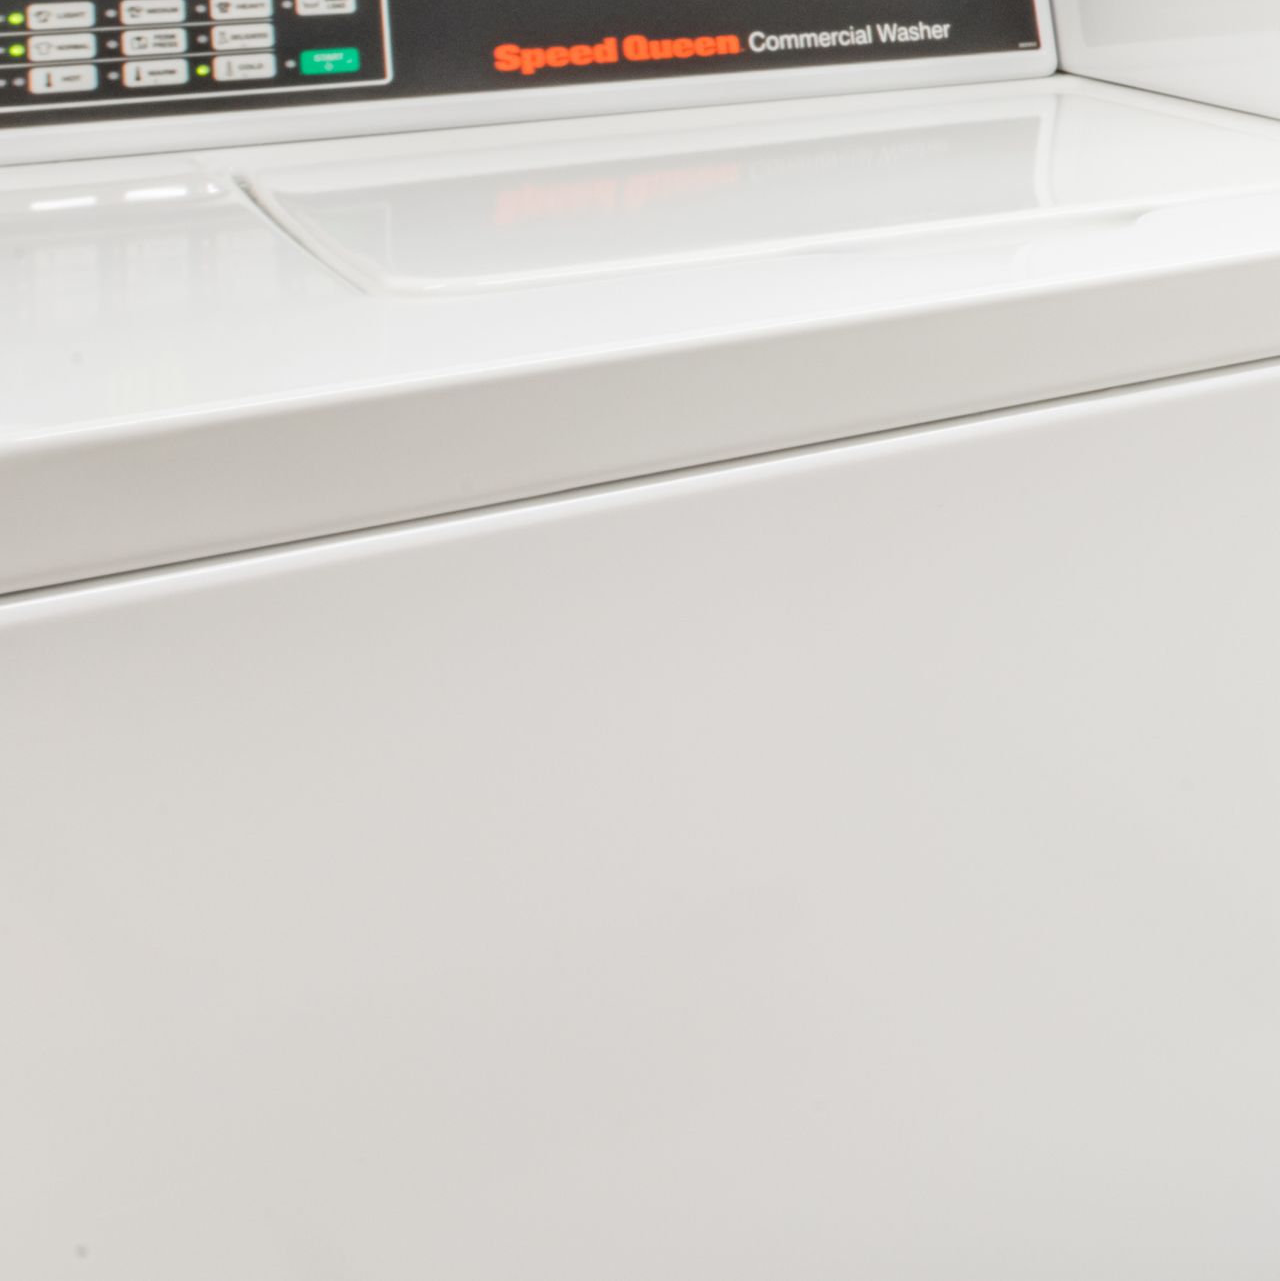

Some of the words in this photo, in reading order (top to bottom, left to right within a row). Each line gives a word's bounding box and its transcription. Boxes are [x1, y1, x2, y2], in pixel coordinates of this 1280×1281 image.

[493, 37, 617, 75] Speed
[623, 33, 740, 61] Queen
[748, 24, 873, 54] Commercial
[876, 21, 951, 44] Washer
